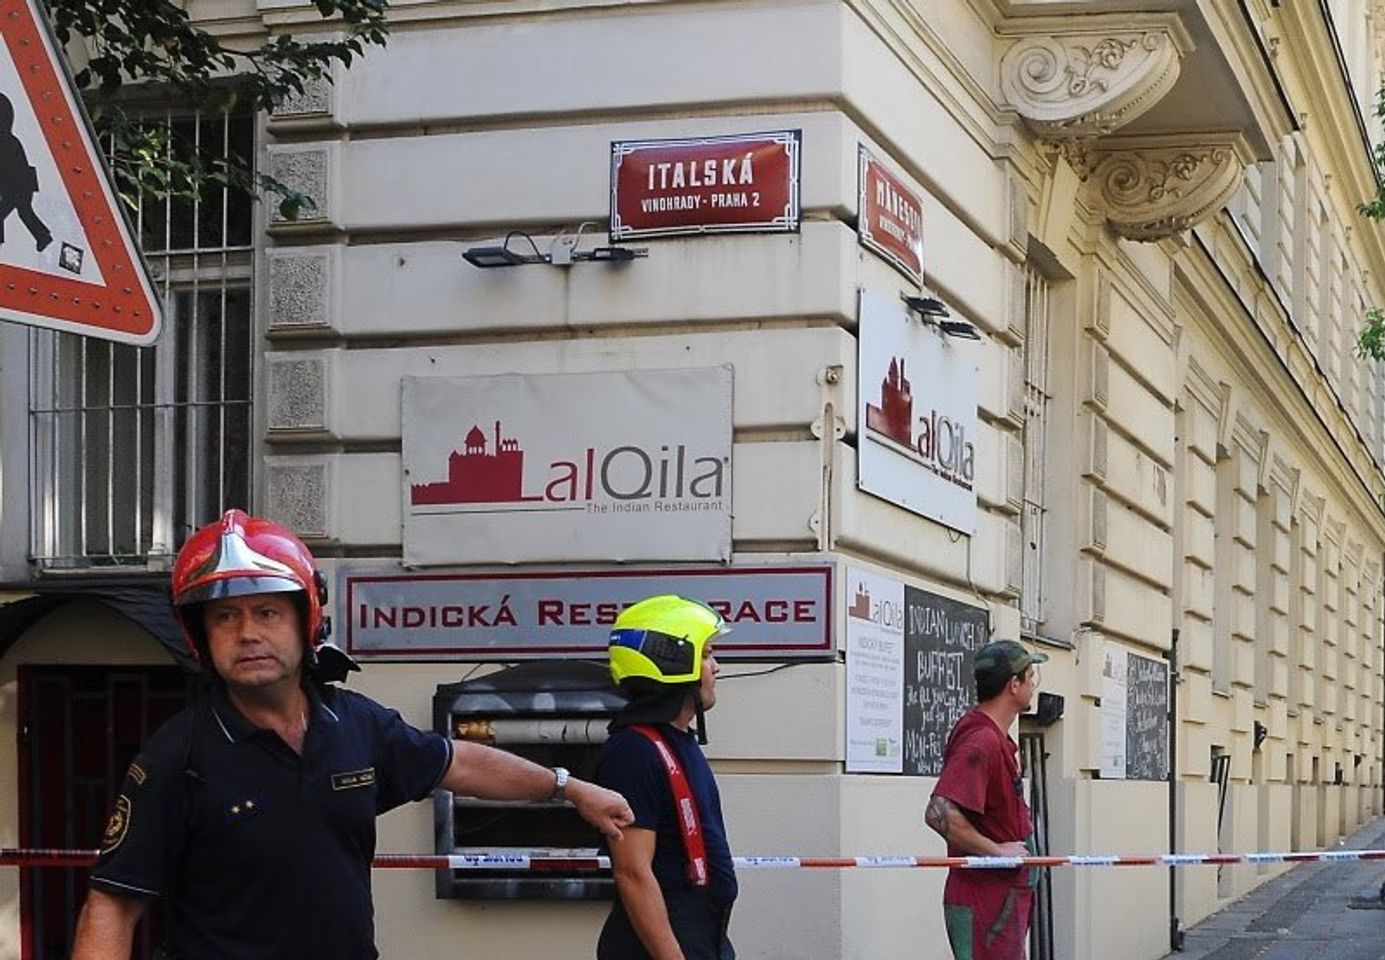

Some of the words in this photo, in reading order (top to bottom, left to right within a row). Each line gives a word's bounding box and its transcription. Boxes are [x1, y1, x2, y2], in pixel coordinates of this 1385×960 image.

[648, 153, 754, 191] ITALSKÁ
[641, 196, 701, 214] VINOHRADY
[711, 194, 748, 208] PRAHA
[752, 191, 760, 208] 2
[612, 501, 650, 513] Indian
[654, 499, 723, 512] Restaurant
[537, 598, 817, 627] RESRACE
